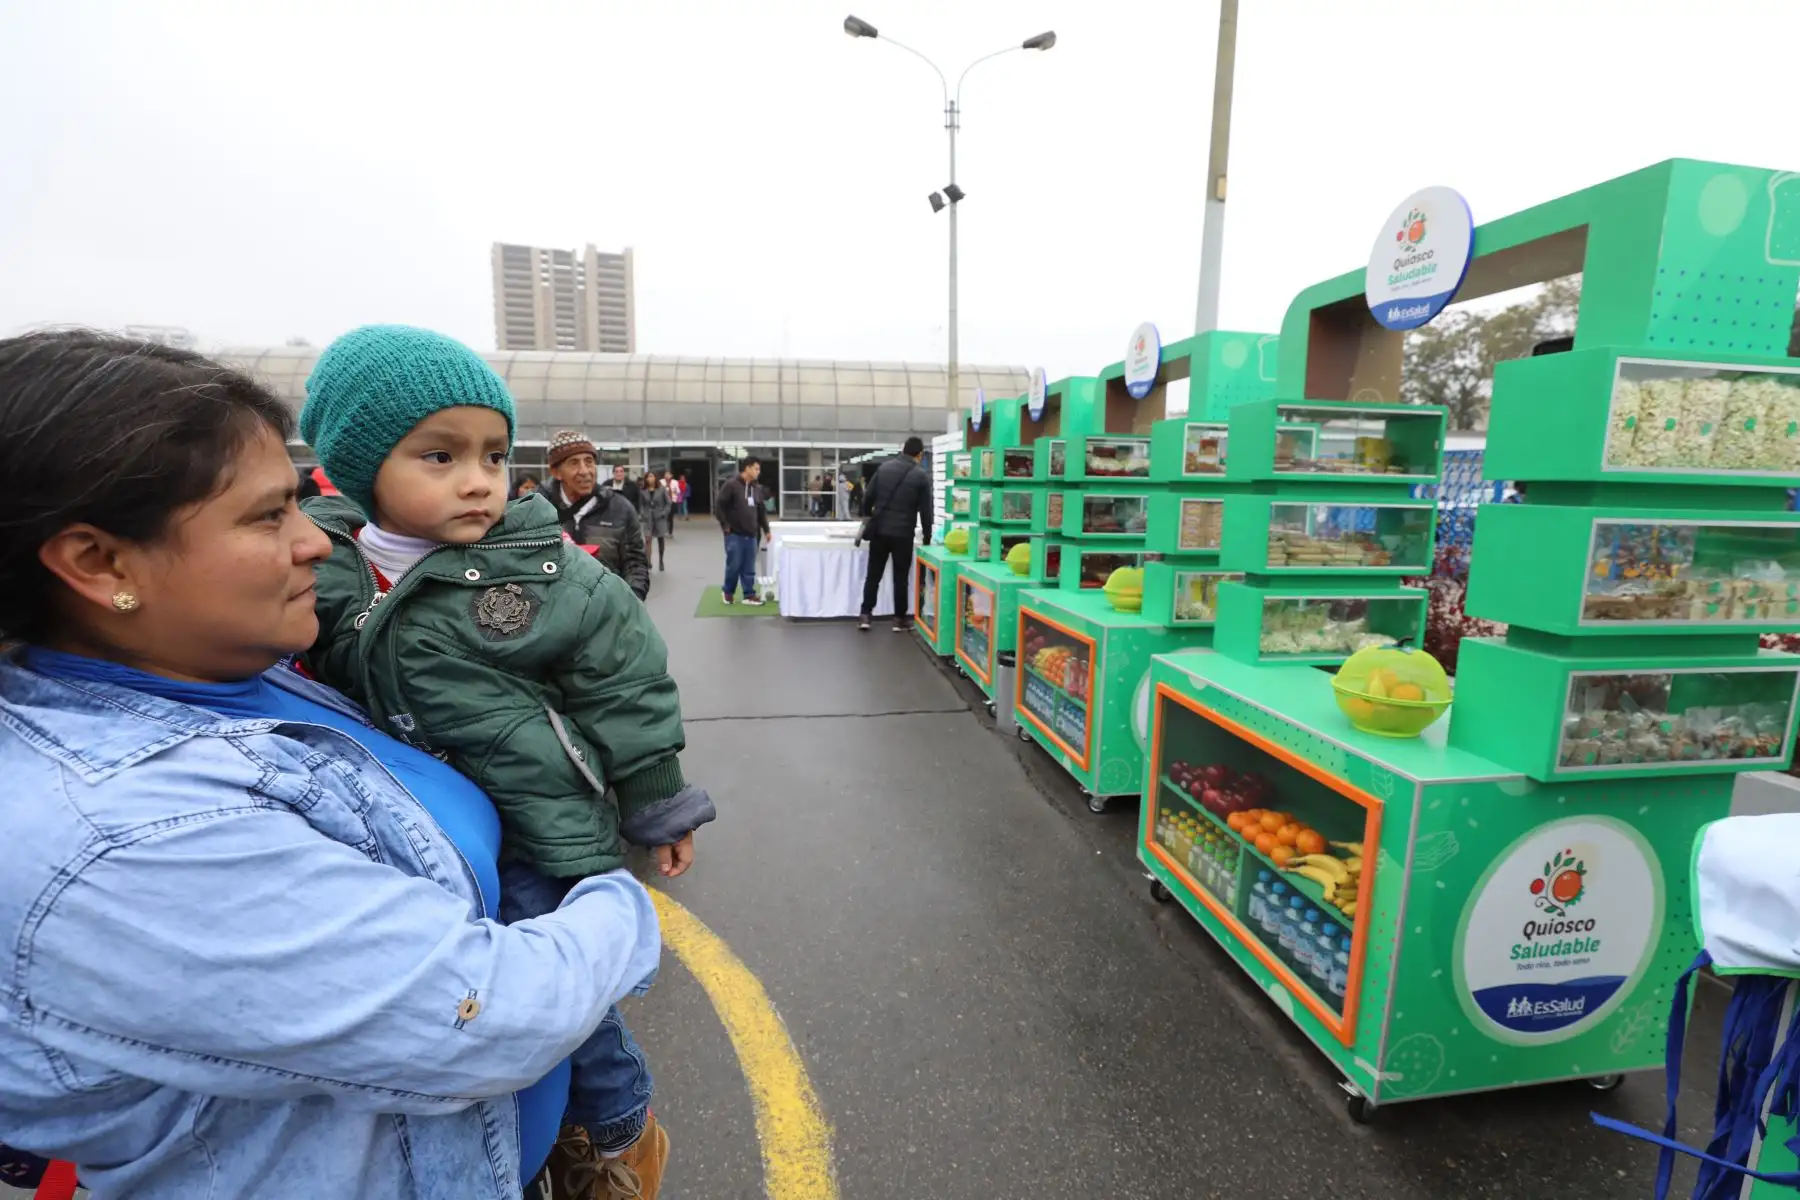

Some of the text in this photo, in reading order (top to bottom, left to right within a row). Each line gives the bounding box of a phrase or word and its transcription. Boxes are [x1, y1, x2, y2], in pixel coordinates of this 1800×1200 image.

[1394, 249, 1434, 271] Quiosco
[1388, 263, 1437, 285] Saludable
[1523, 918, 1596, 941] Quiosco
[1510, 936, 1600, 960] Saludable
[1534, 996, 1585, 1014] EsSalud
